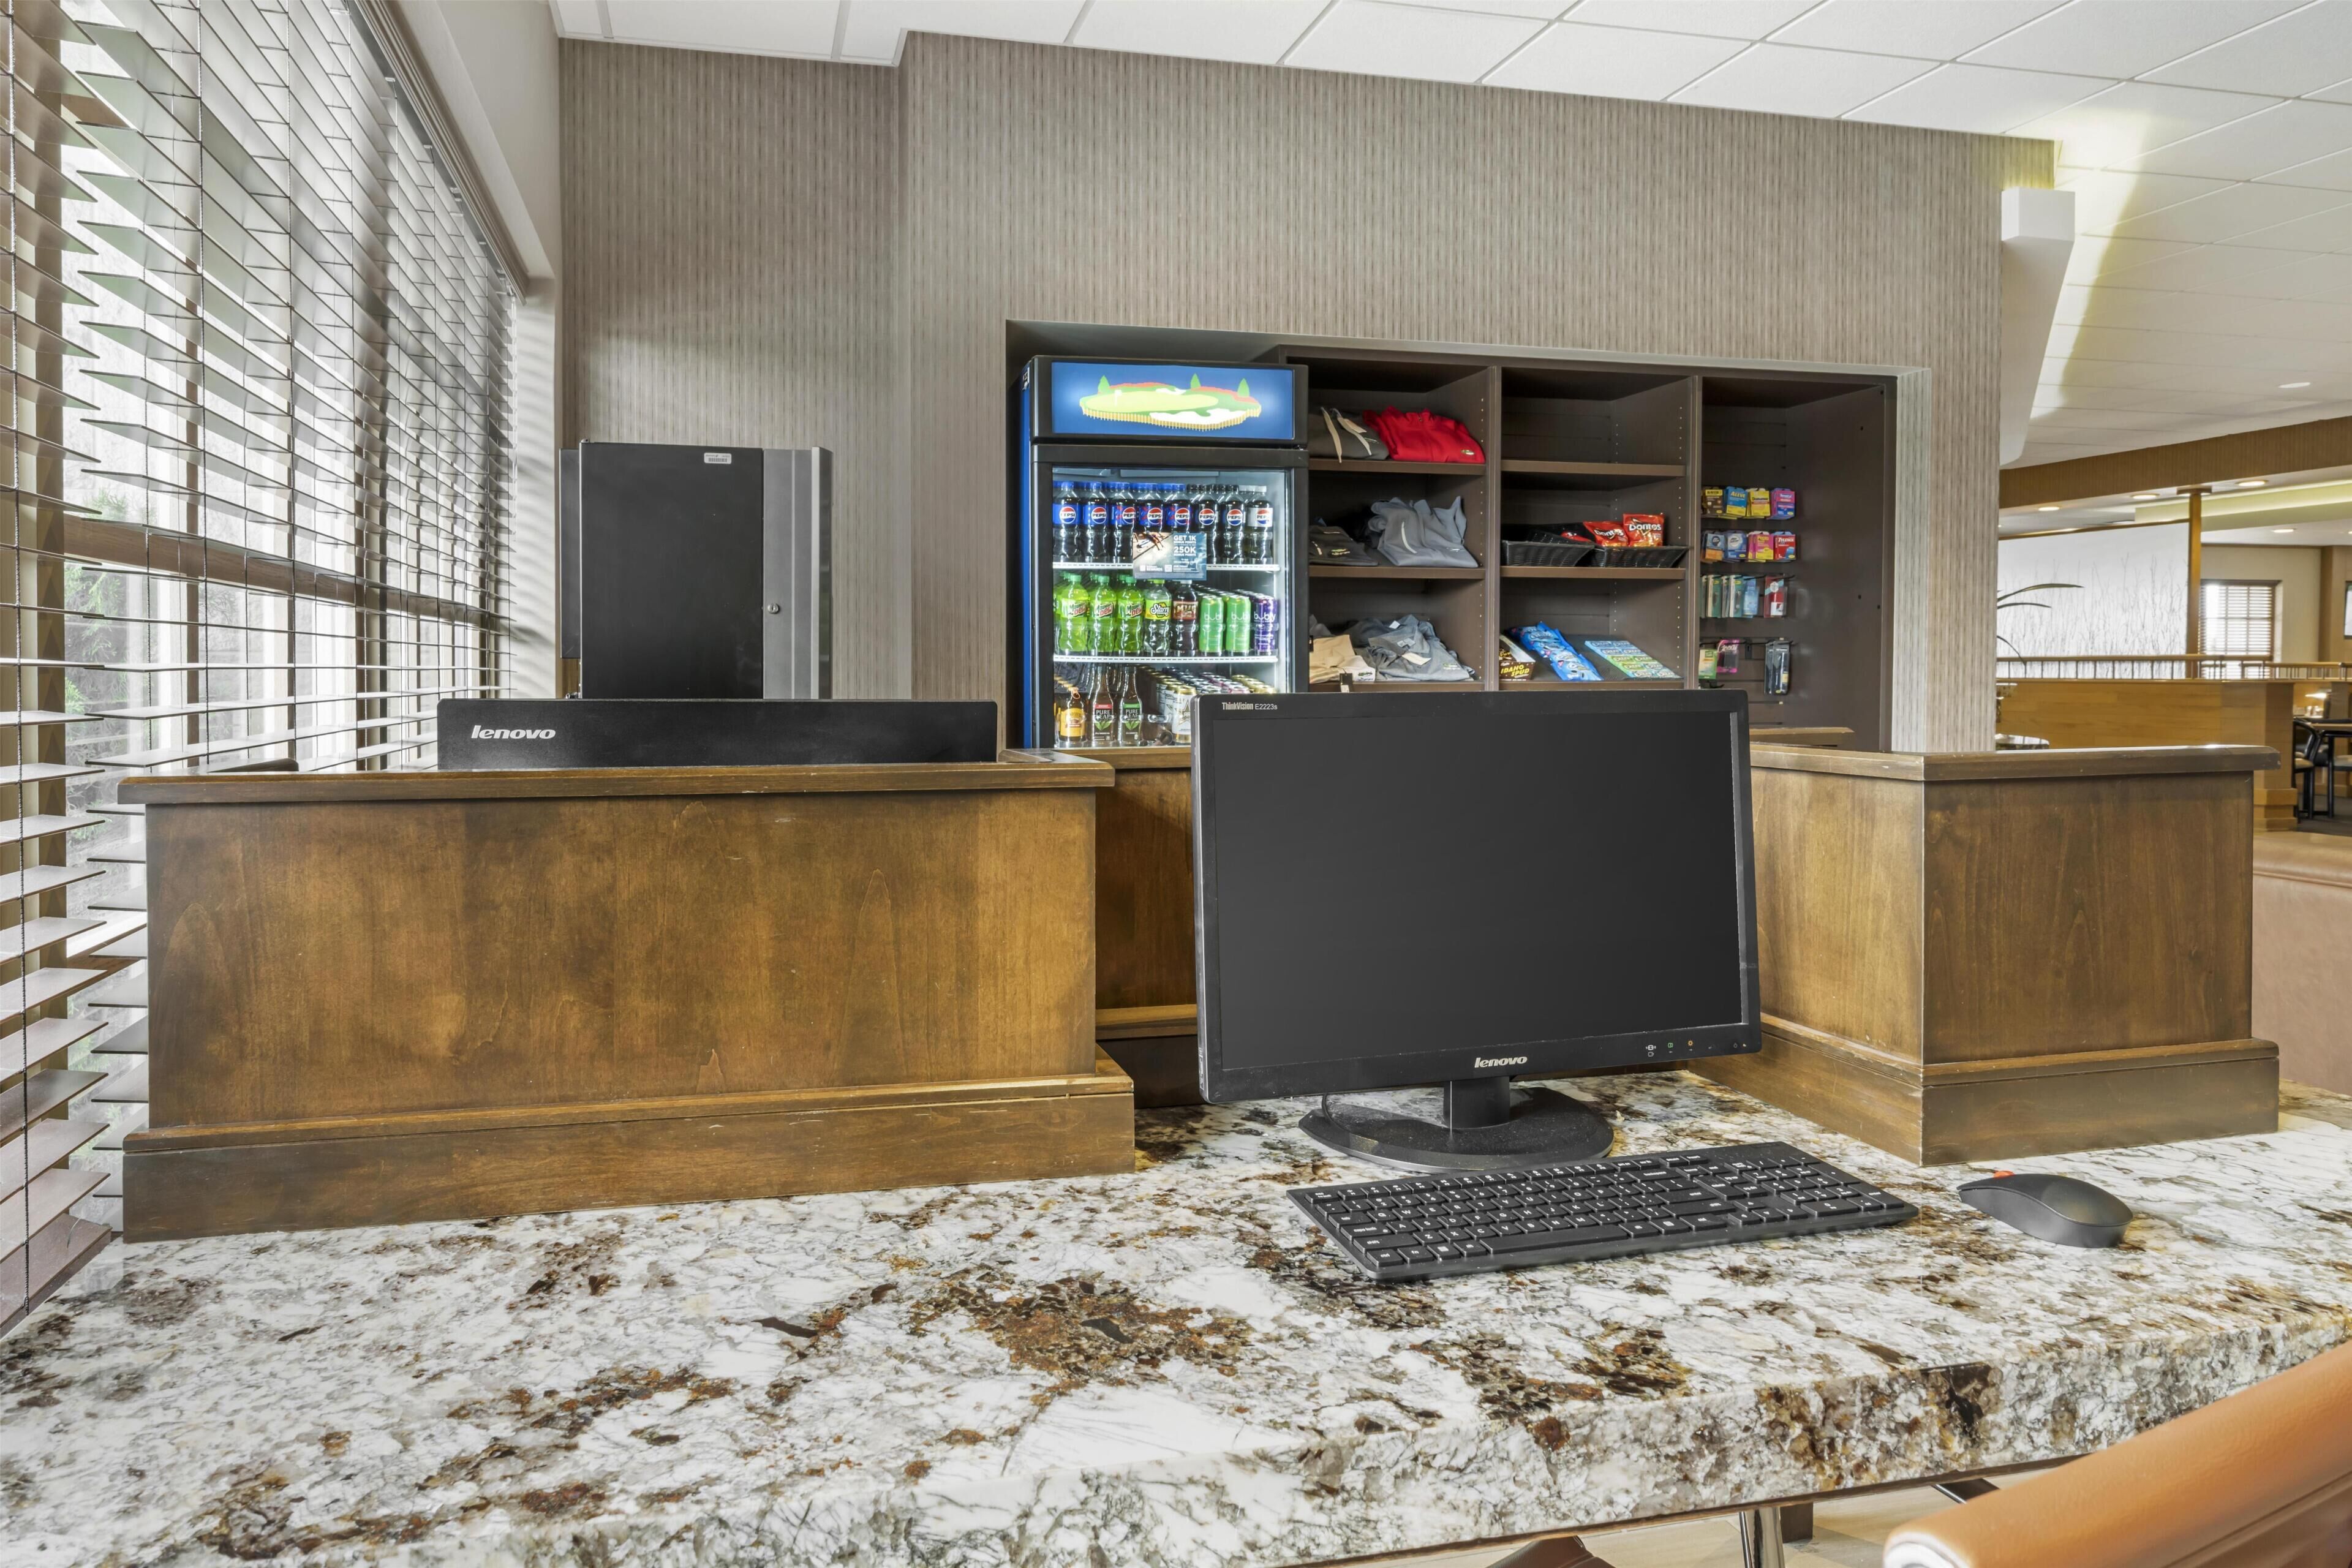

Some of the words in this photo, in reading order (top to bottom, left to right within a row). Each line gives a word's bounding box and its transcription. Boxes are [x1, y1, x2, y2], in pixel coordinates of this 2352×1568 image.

[1204, 612, 1221, 620] bub
[1231, 611, 1248, 620] bub
[1501, 665, 1524, 674] IDAHO
[1511, 668, 1529, 677] SPUD
[471, 725, 556, 739] lenovo
[1474, 1056, 1528, 1068] lenovo
